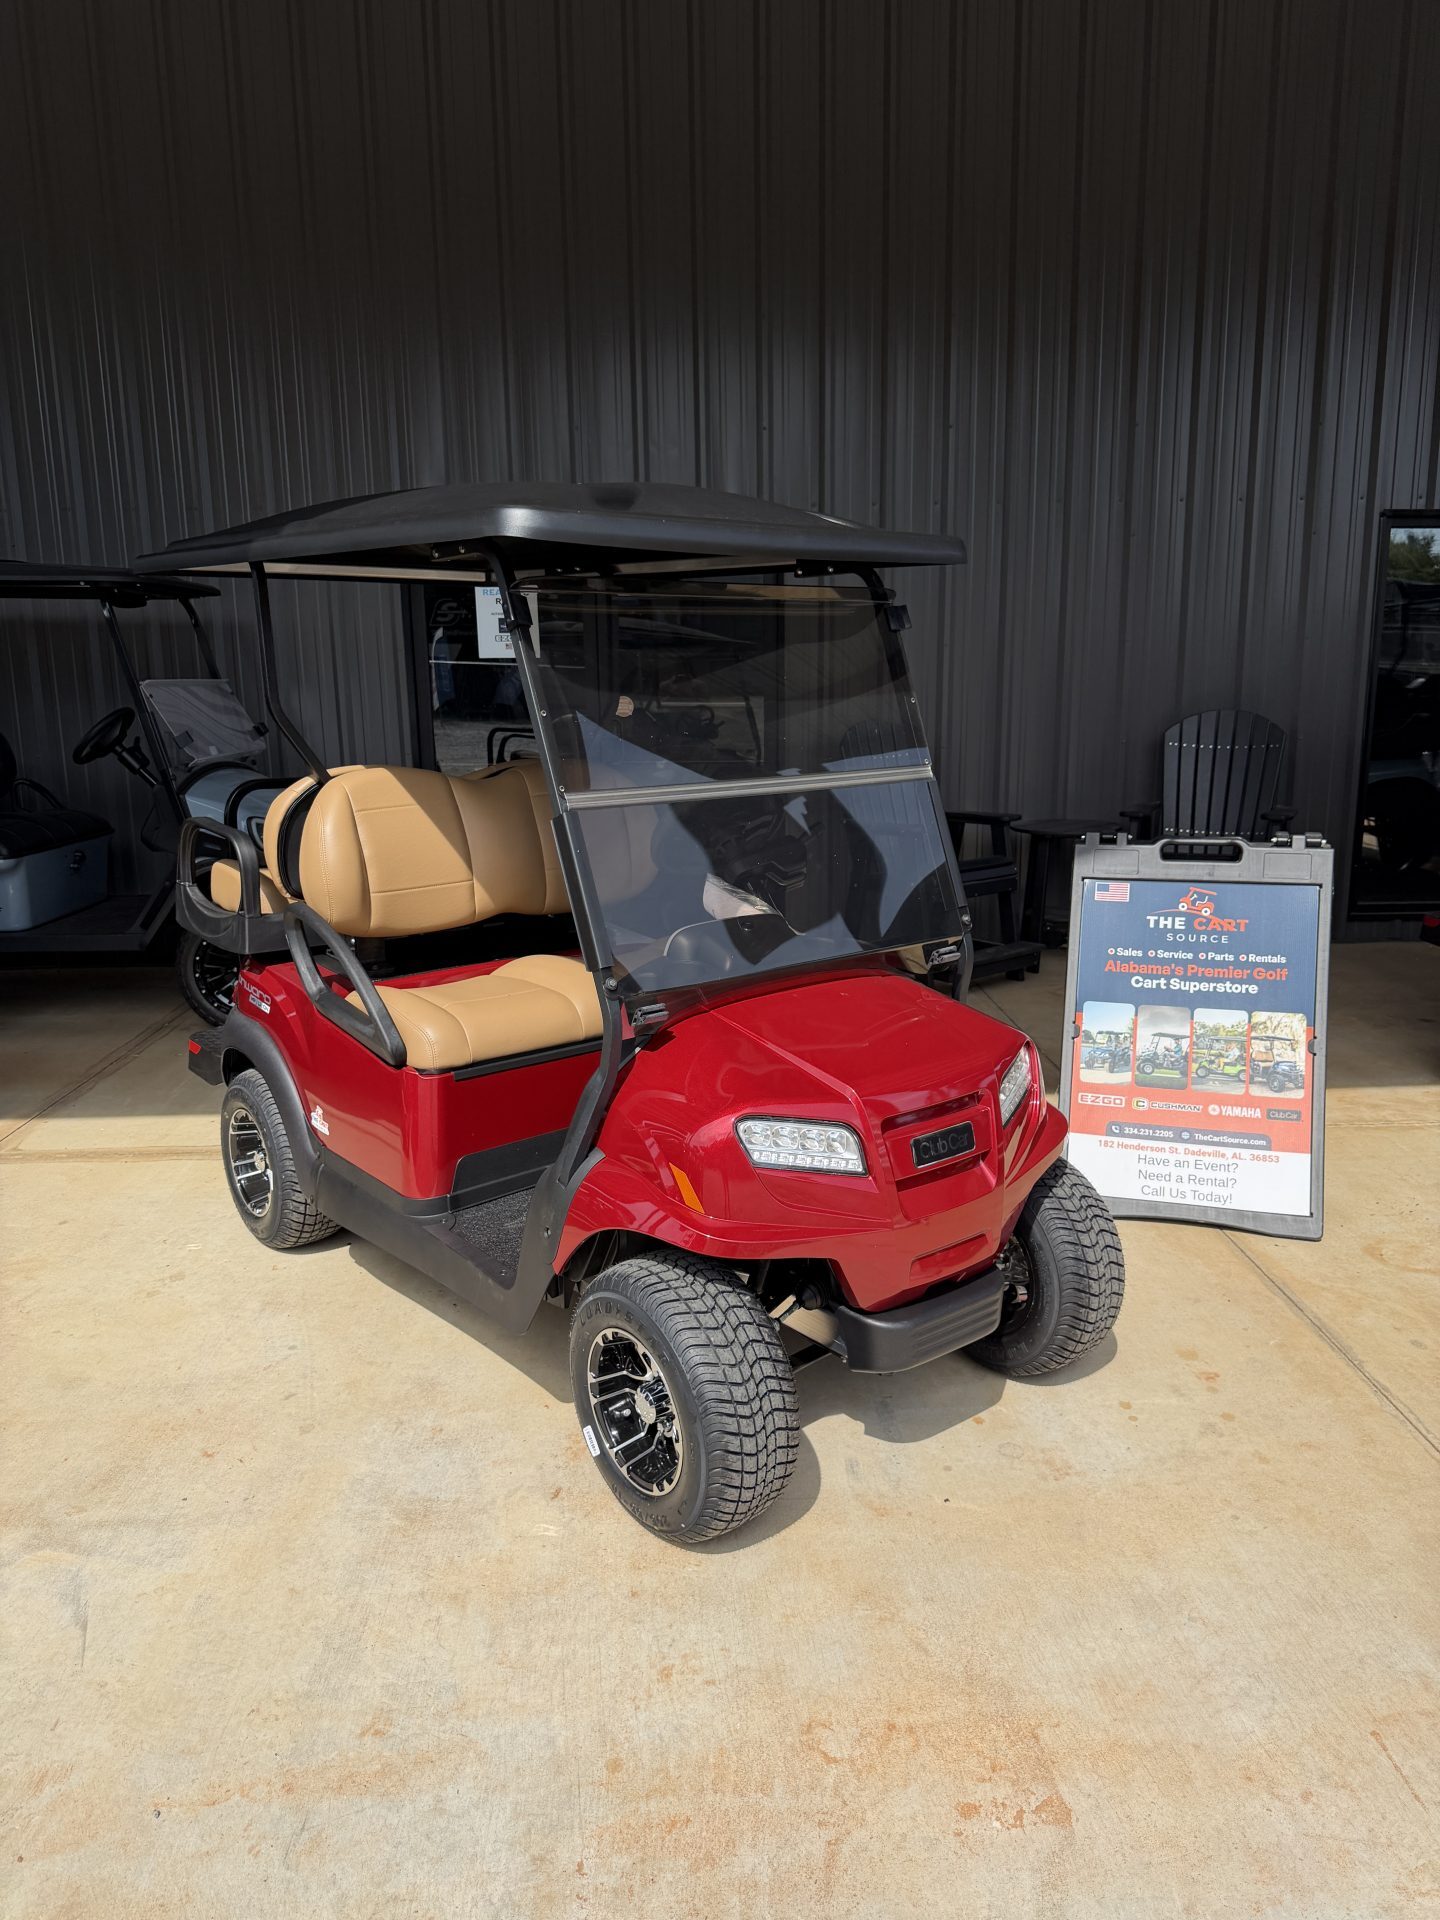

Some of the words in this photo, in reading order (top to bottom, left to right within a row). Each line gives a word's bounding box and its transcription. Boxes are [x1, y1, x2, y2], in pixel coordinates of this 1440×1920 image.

[1146, 915, 1186, 930] THE
[1193, 917, 1249, 932] CART
[1166, 933, 1229, 944] SOURCE
[1116, 947, 1143, 957] Sales
[1157, 949, 1193, 960] Service
[1207, 952, 1235, 962] Parts
[1248, 954, 1287, 964] Rentals
[1104, 960, 1183, 976] Alabama's
[1187, 964, 1250, 979] Premier
[1252, 967, 1289, 981] Golf
[1130, 975, 1167, 990] Cart
[1169, 977, 1259, 994] Superstore
[1150, 1101, 1201, 1112] CUSHMAN
[1220, 1105, 1262, 1119] YAMAHA
[1124, 1126, 1174, 1138] 334.231.2205
[1194, 1133, 1267, 1146] TheCartSource.com
[1098, 1139, 1115, 1148] 182
[1117, 1140, 1166, 1153] Henderson
[1168, 1146, 1181, 1155] St.
[1183, 1147, 1229, 1160] Dadeville,
[1231, 1152, 1247, 1161] AL.
[1249, 1153, 1280, 1164] 36853
[1137, 1153, 1170, 1167] Have
[1174, 1160, 1190, 1168] an
[1194, 1159, 1239, 1173] Event?
[1138, 1169, 1171, 1182] Need
[1175, 1175, 1183, 1184] a
[1188, 1174, 1237, 1189] Rental?
[1141, 1184, 1165, 1197] Call
[1169, 1187, 1187, 1199] Us
[1190, 1189, 1233, 1206] Today!
